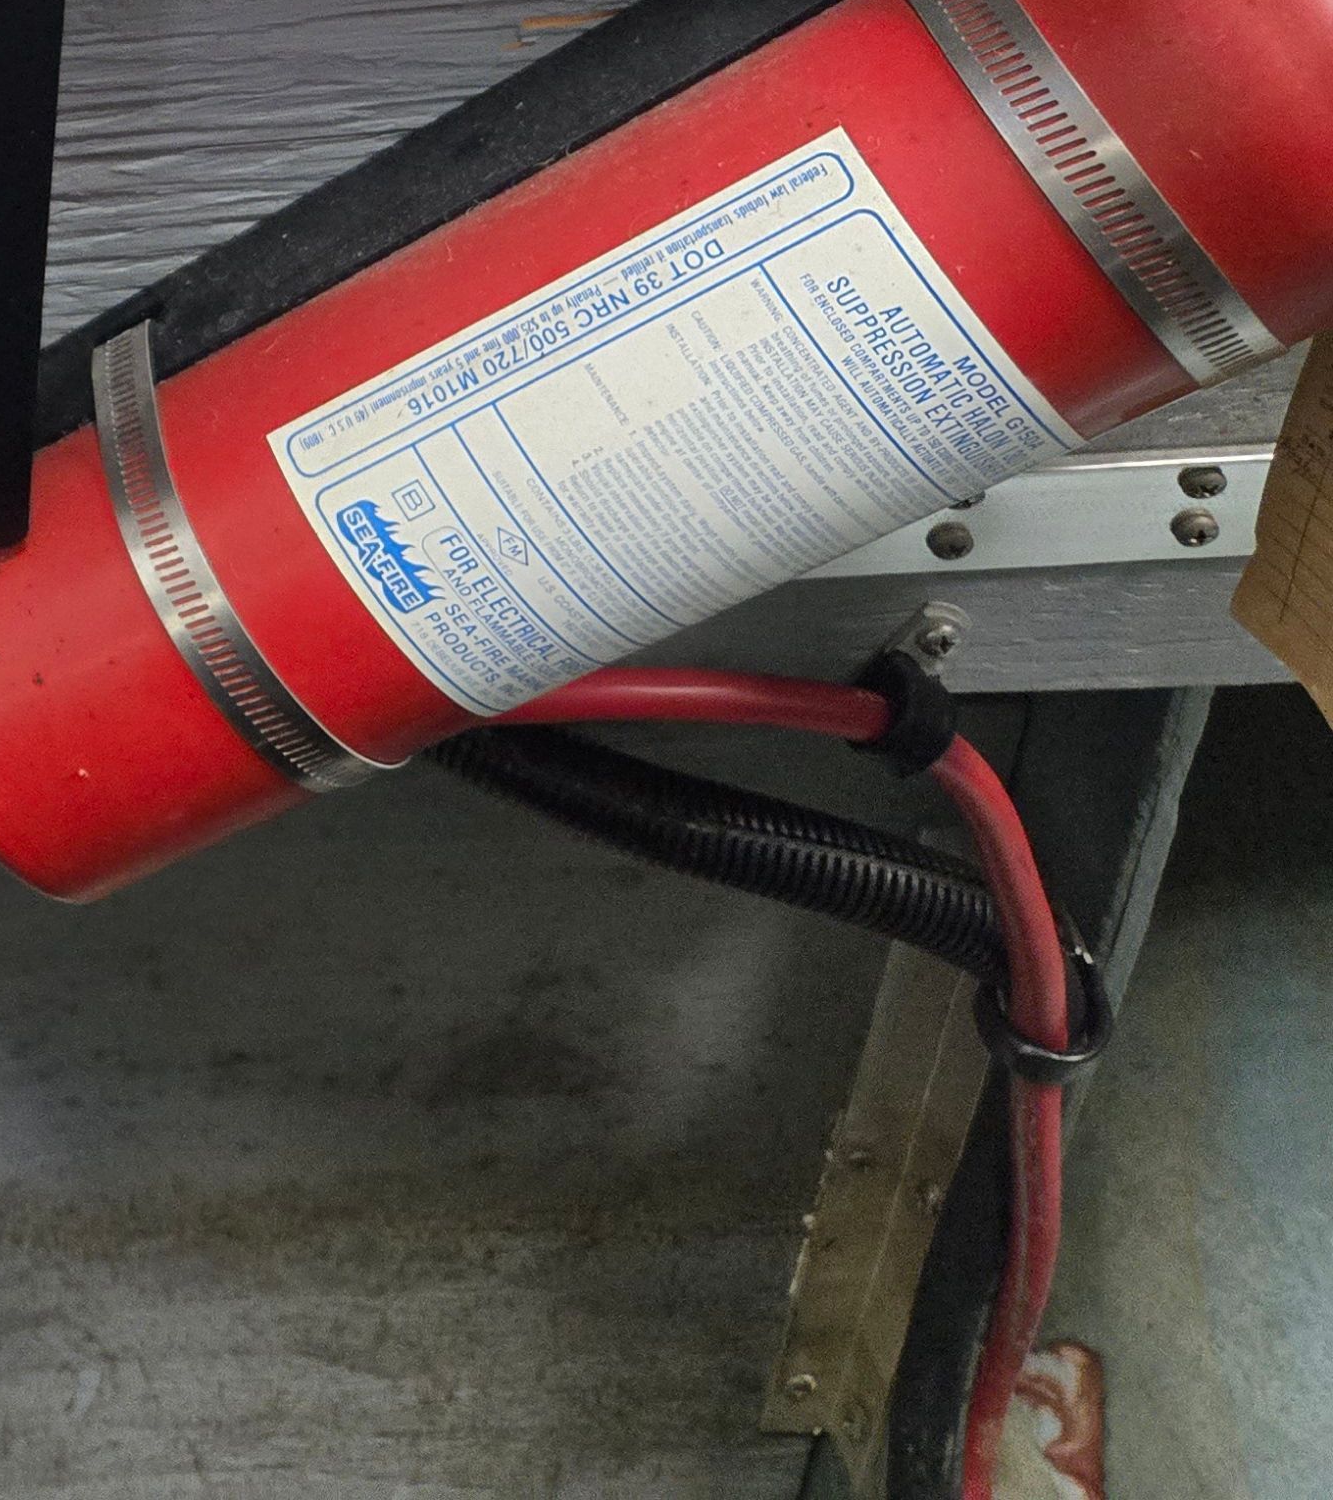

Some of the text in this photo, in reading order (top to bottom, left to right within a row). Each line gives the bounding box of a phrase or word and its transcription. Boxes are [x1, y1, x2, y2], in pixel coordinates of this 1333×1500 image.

[766, 181, 790, 203] law
[786, 161, 829, 193] Federal
[731, 192, 771, 222] forbids
[662, 211, 735, 259] transportation
[619, 252, 657, 282] refilled
[537, 308, 552, 326] to
[549, 301, 566, 319] up
[563, 281, 603, 312] Penalty
[404, 237, 726, 418] DOT 39 NRC 500/720 M1016
[480, 335, 502, 356] fine
[499, 315, 540, 346] $25,000
[824, 274, 937, 405] SUPPRESSION
[427, 360, 456, 385] years
[461, 345, 483, 366] and
[767, 330, 805, 373] breathing
[797, 272, 820, 294] FOR
[812, 293, 857, 344] ENCLOSED
[848, 341, 912, 415] COMPARTMENTS
[903, 412, 923, 427] UP
[914, 424, 932, 437] TO
[368, 374, 430, 416] imprisonment
[745, 342, 768, 366] Prior
[761, 364, 777, 377] to
[804, 422, 827, 442] read
[757, 336, 809, 399] INSTALLATION
[802, 397, 825, 419] MAY
[817, 417, 847, 446] CAUSE
[780, 324, 837, 393] CONCENTRATED
[830, 391, 859, 420] AGENT
[852, 419, 873, 438] AND
[877, 302, 975, 409] AUTOMATIC
[960, 405, 1013, 450] HALON
[951, 354, 1015, 418] MODEL
[709, 388, 732, 412] Prior
[724, 410, 740, 422] to
[747, 393, 795, 448] COMPRESSED
[757, 382, 781, 406] Keep
[773, 403, 798, 428] away
[790, 425, 813, 446] from
[838, 354, 865, 380] WILL
[857, 378, 918, 445] AUTOMATICALLY
[400, 487, 426, 513] B
[501, 535, 524, 558] FM
[438, 531, 481, 575] FOR
[469, 575, 565, 662] ELECTRICAL
[442, 565, 474, 598] AND
[466, 597, 538, 662] FLAMMABLE
[441, 601, 512, 667] SEA-FIRE
